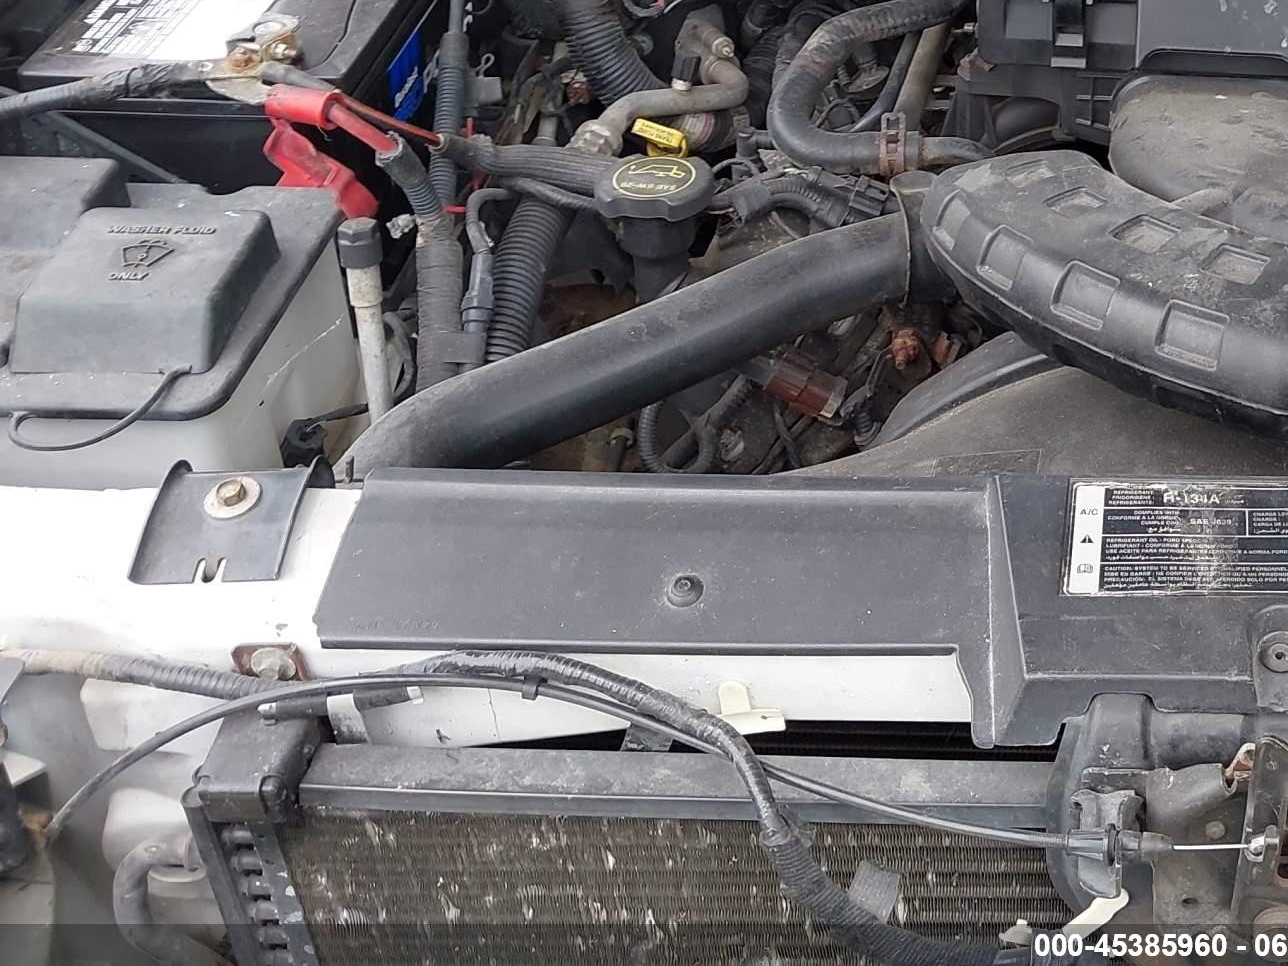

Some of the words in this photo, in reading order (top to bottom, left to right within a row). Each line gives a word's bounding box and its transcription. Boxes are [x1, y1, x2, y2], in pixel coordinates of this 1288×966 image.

[108, 225, 170, 234] WASHER
[173, 226, 217, 234] FLUID
[108, 272, 150, 281] ONLY
[1080, 508, 1099, 516] A/C
